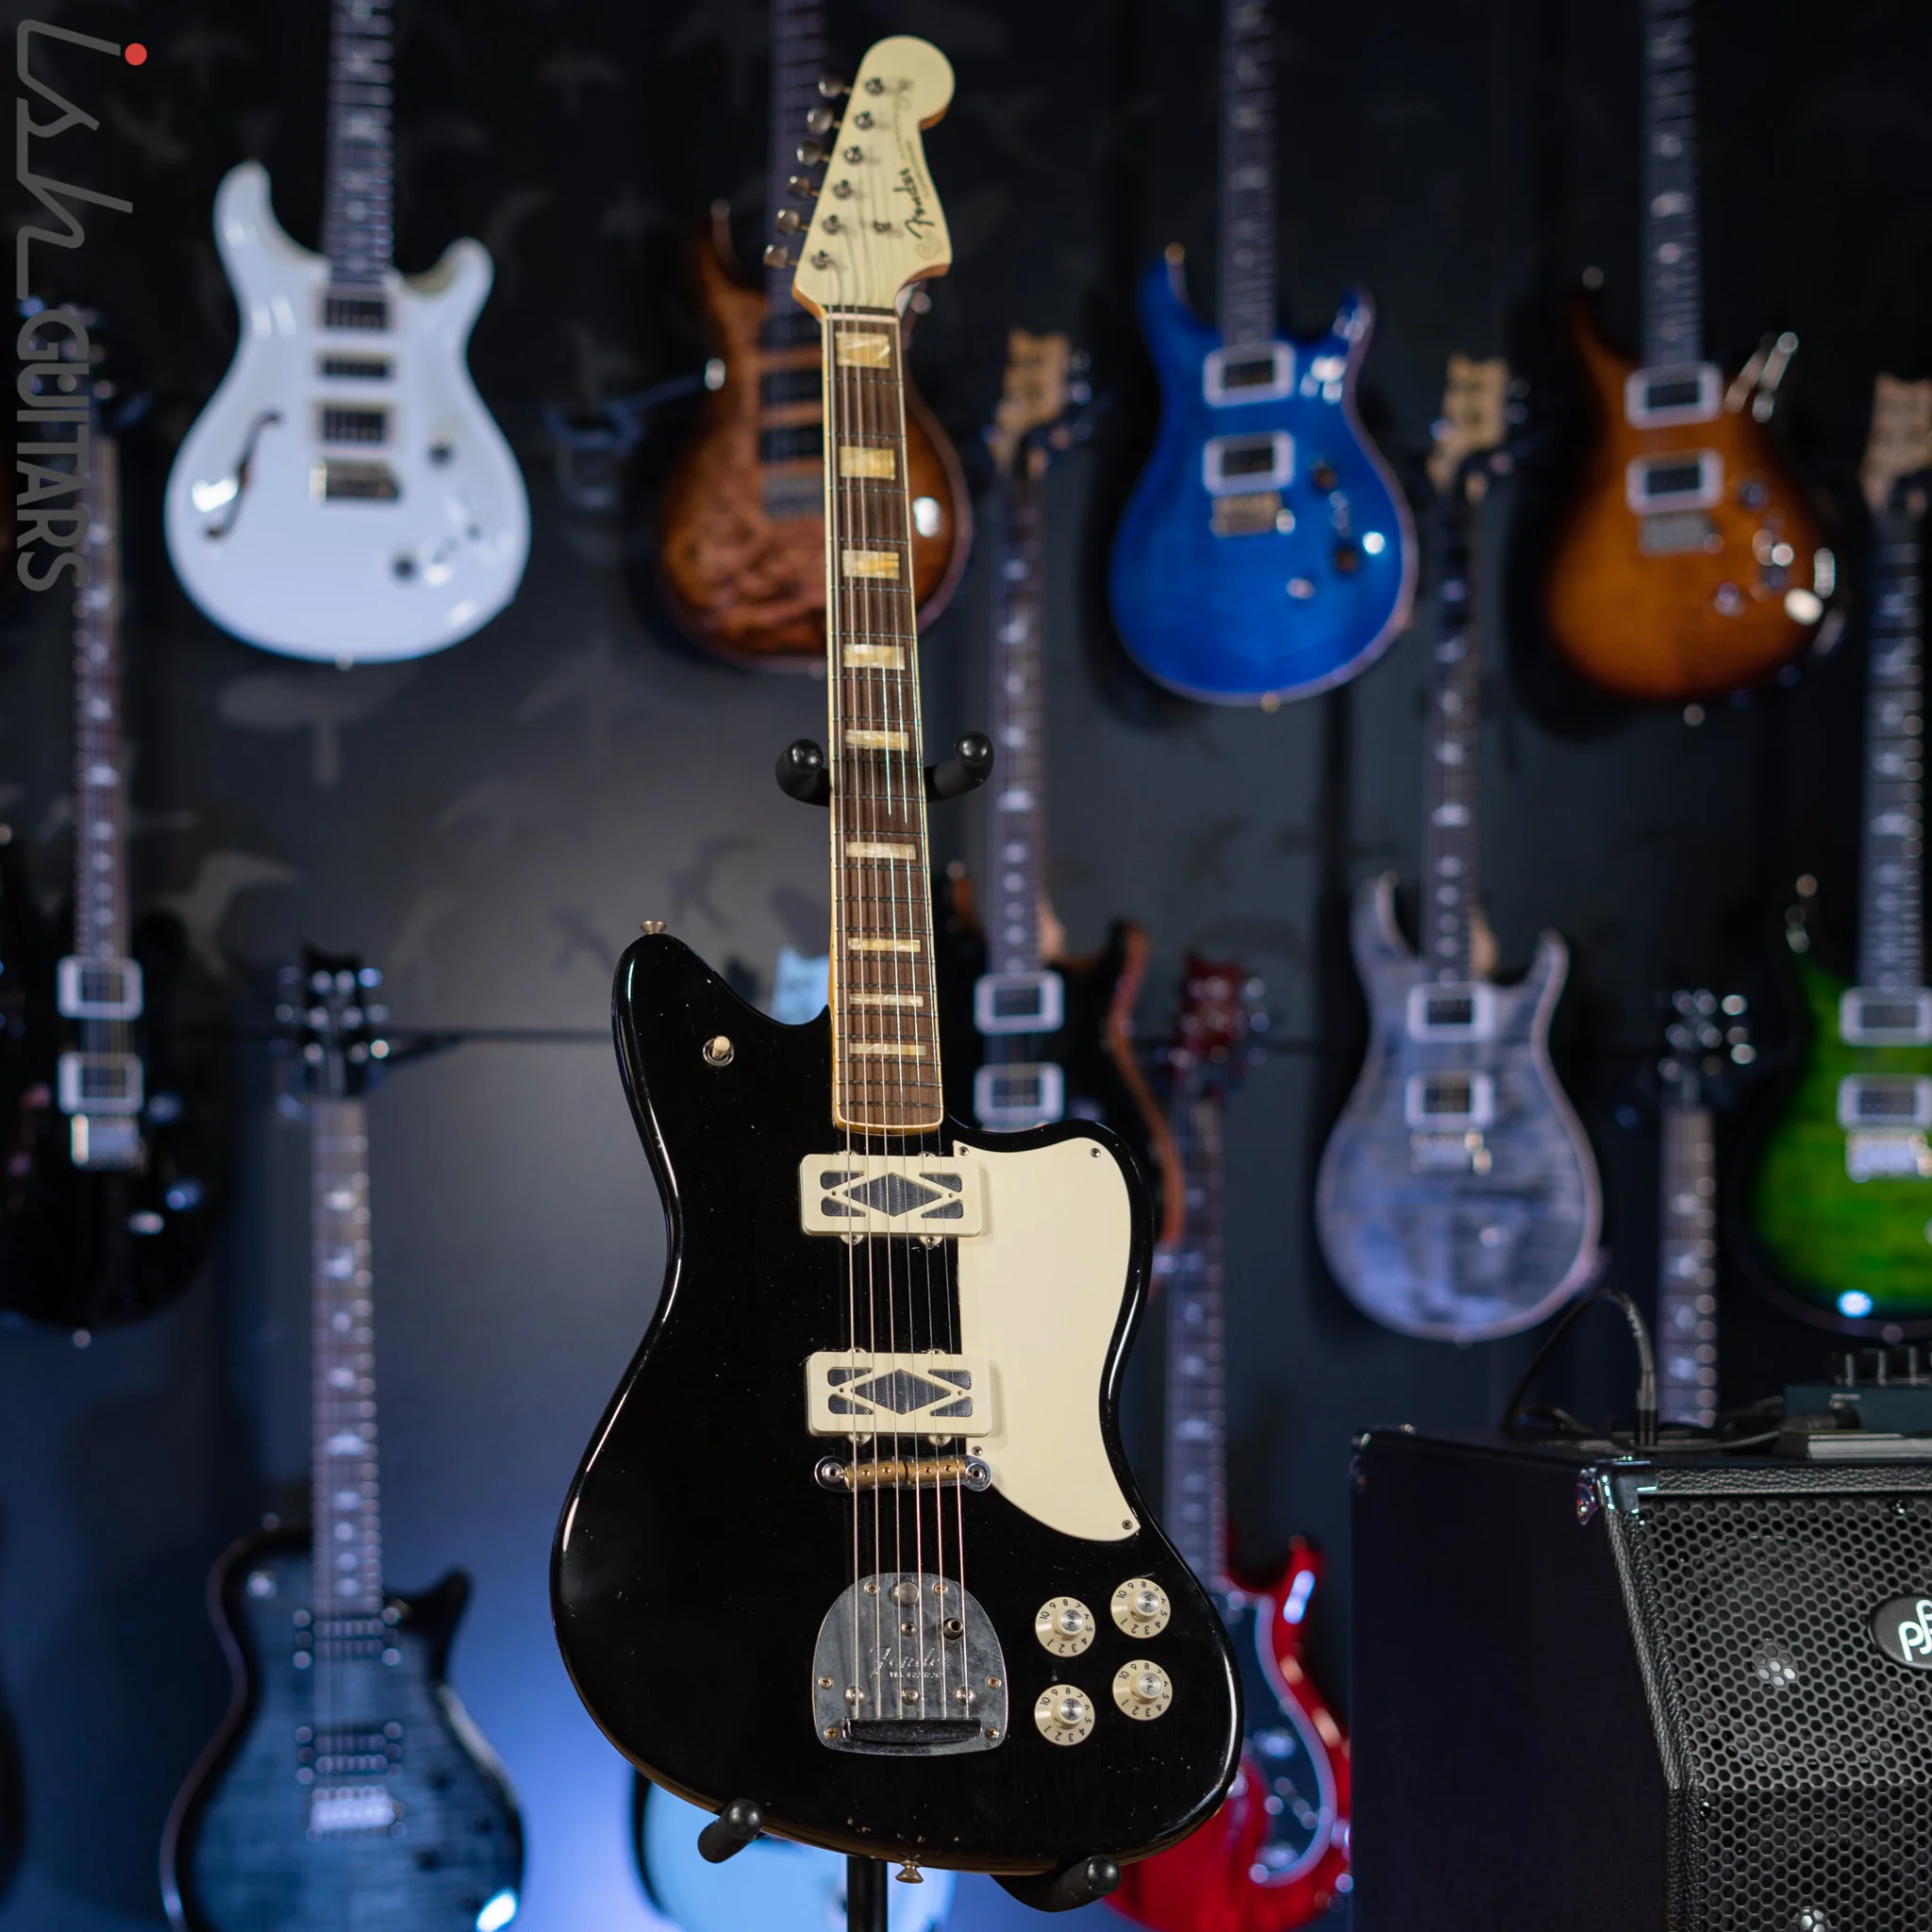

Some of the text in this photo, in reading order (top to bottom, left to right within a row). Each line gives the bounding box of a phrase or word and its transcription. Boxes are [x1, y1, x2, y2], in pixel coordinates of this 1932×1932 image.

[893, 167, 935, 239] Fender
[1116, 1590, 1127, 1599] 10
[1062, 1598, 1068, 1607] 8
[1039, 1610, 1050, 1620] 10
[1131, 1624, 1139, 1634] 2
[1144, 1625, 1150, 1635] 3
[1058, 1643, 1065, 1654] 2
[1072, 1643, 1077, 1653] 3
[1118, 1670, 1130, 1680] 10
[1065, 1687, 1072, 1695] 8
[1040, 1696, 1051, 1706] 10
[1067, 1700, 1076, 1719] TONE
[1132, 1706, 1140, 1715] 2
[1145, 1707, 1151, 1718] 3
[1055, 1731, 1062, 1741] 2
[1068, 1732, 1074, 1742] 3
